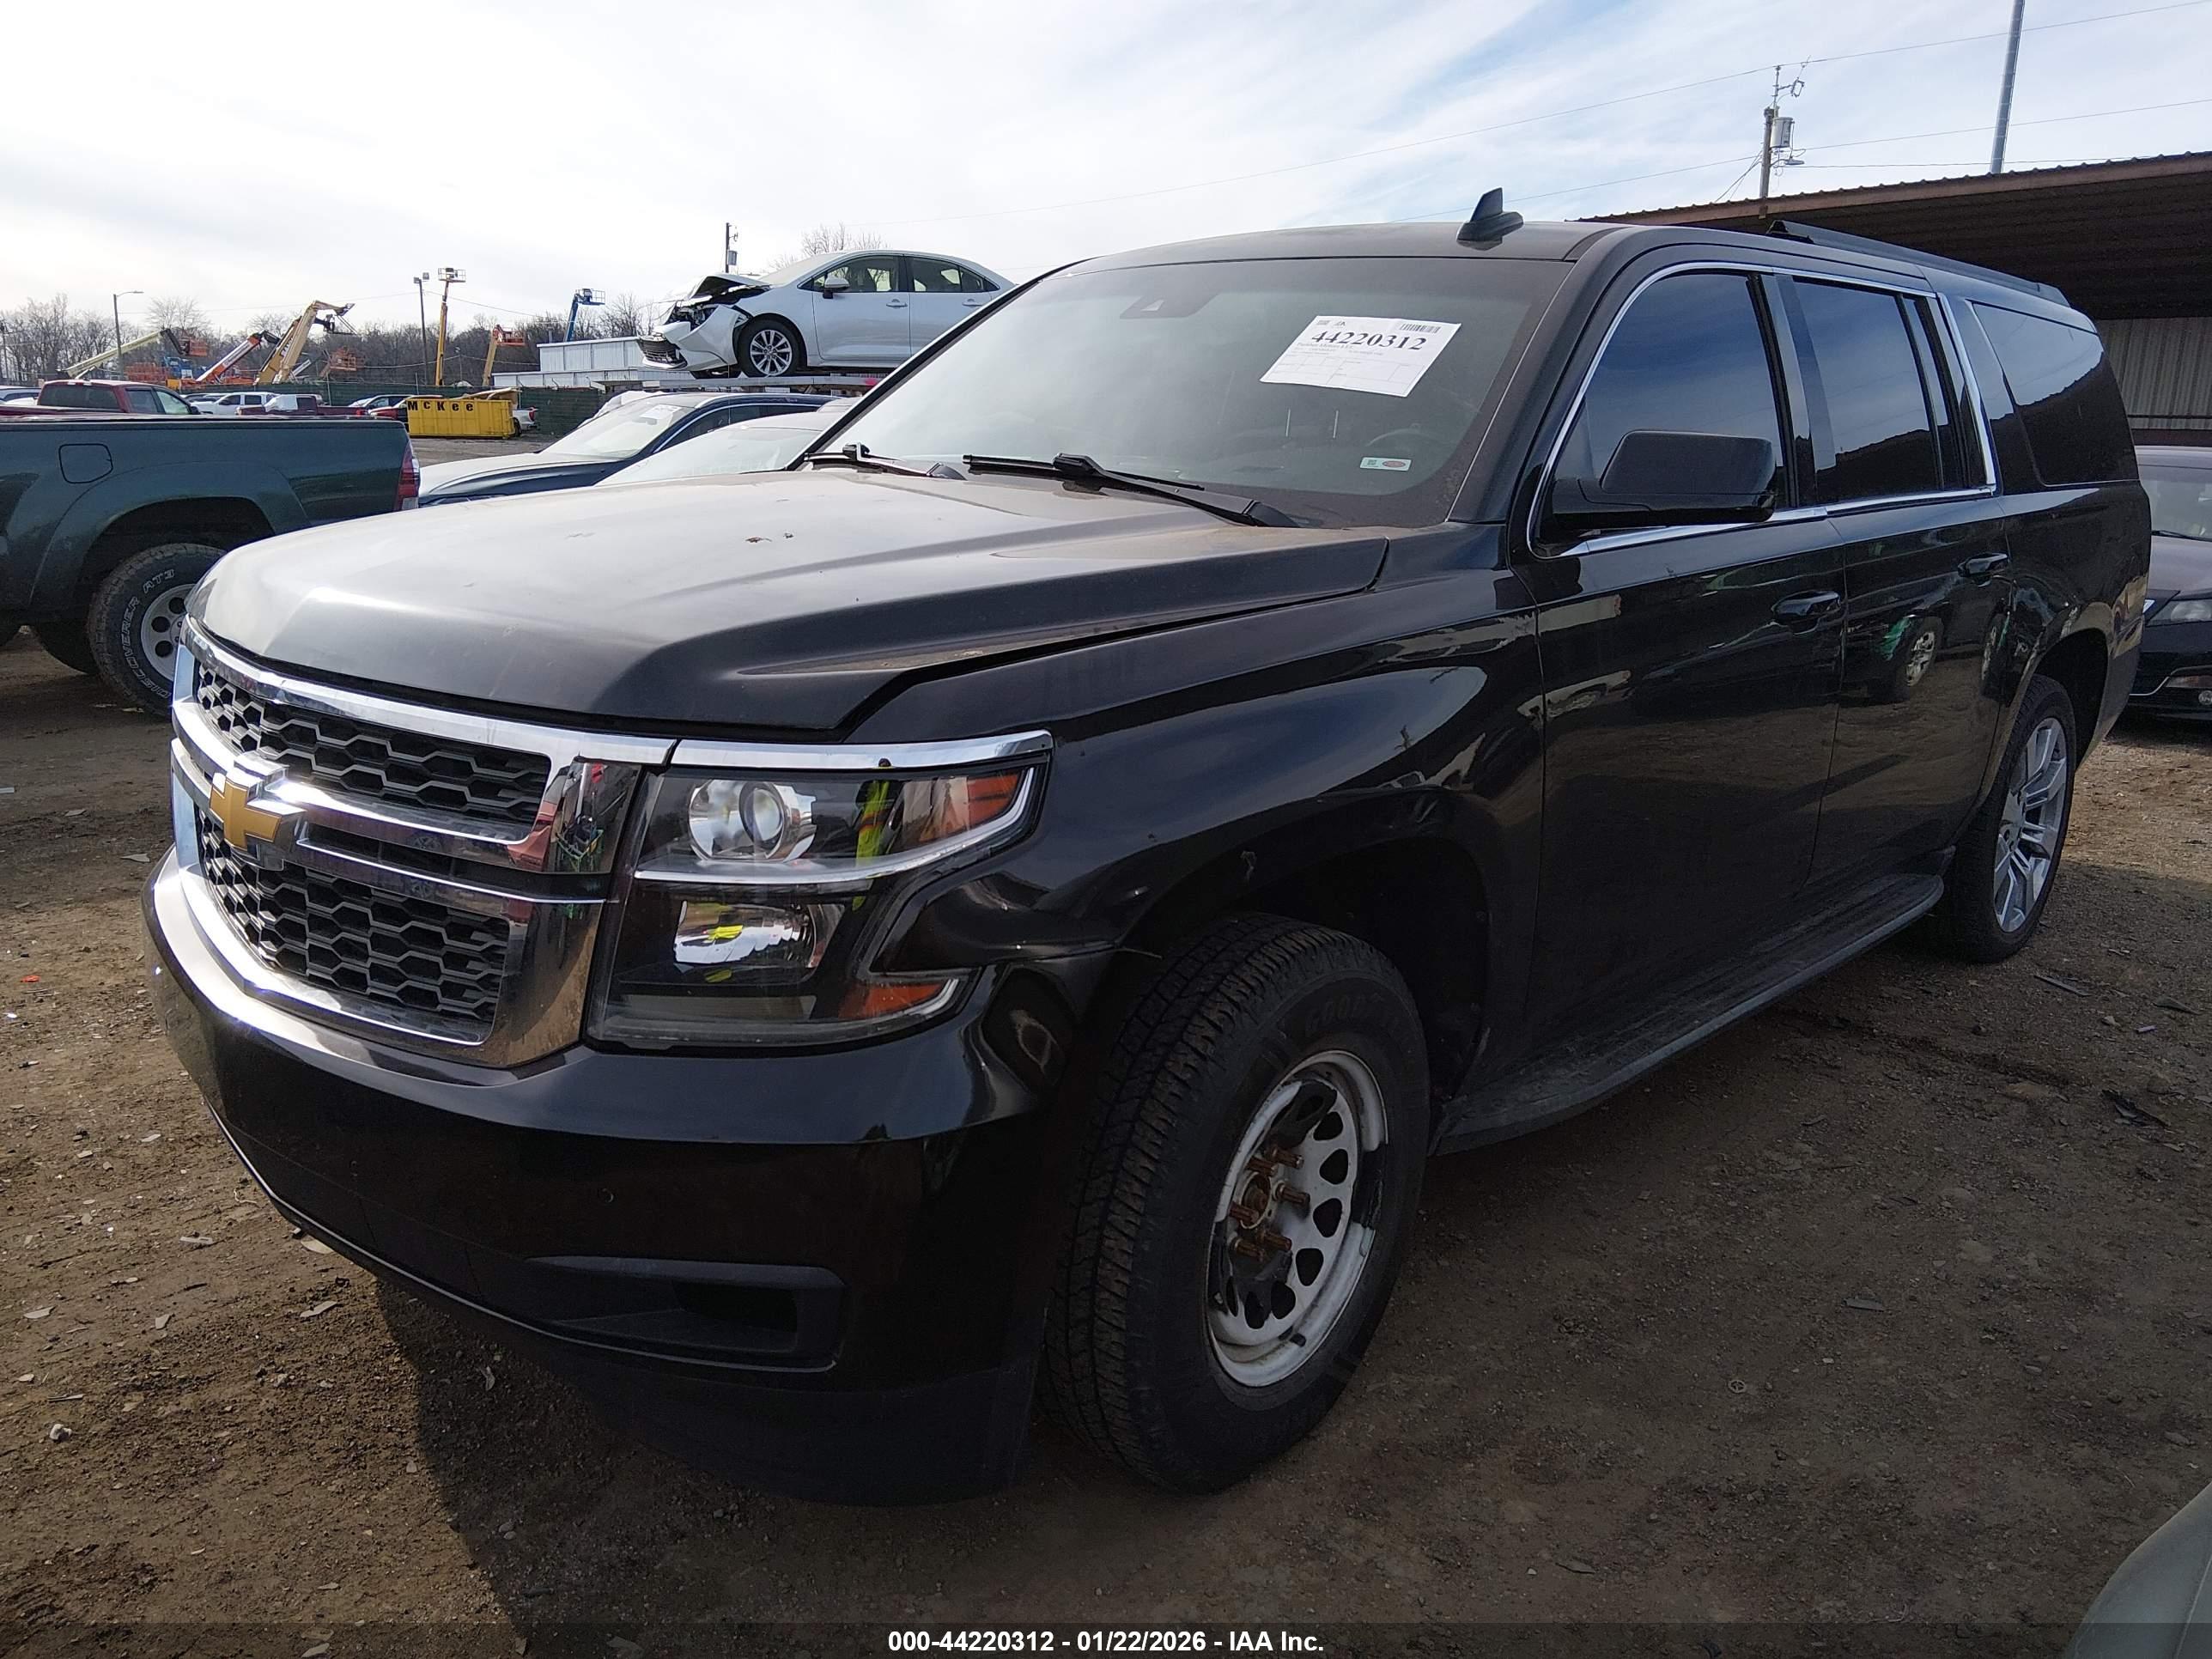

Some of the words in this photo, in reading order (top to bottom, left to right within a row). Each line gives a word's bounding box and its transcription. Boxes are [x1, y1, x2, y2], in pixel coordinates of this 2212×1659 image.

[1311, 331, 1427, 349] 44220312
[143, 568, 175, 593] AT3
[121, 596, 171, 698] DISCOVERER
